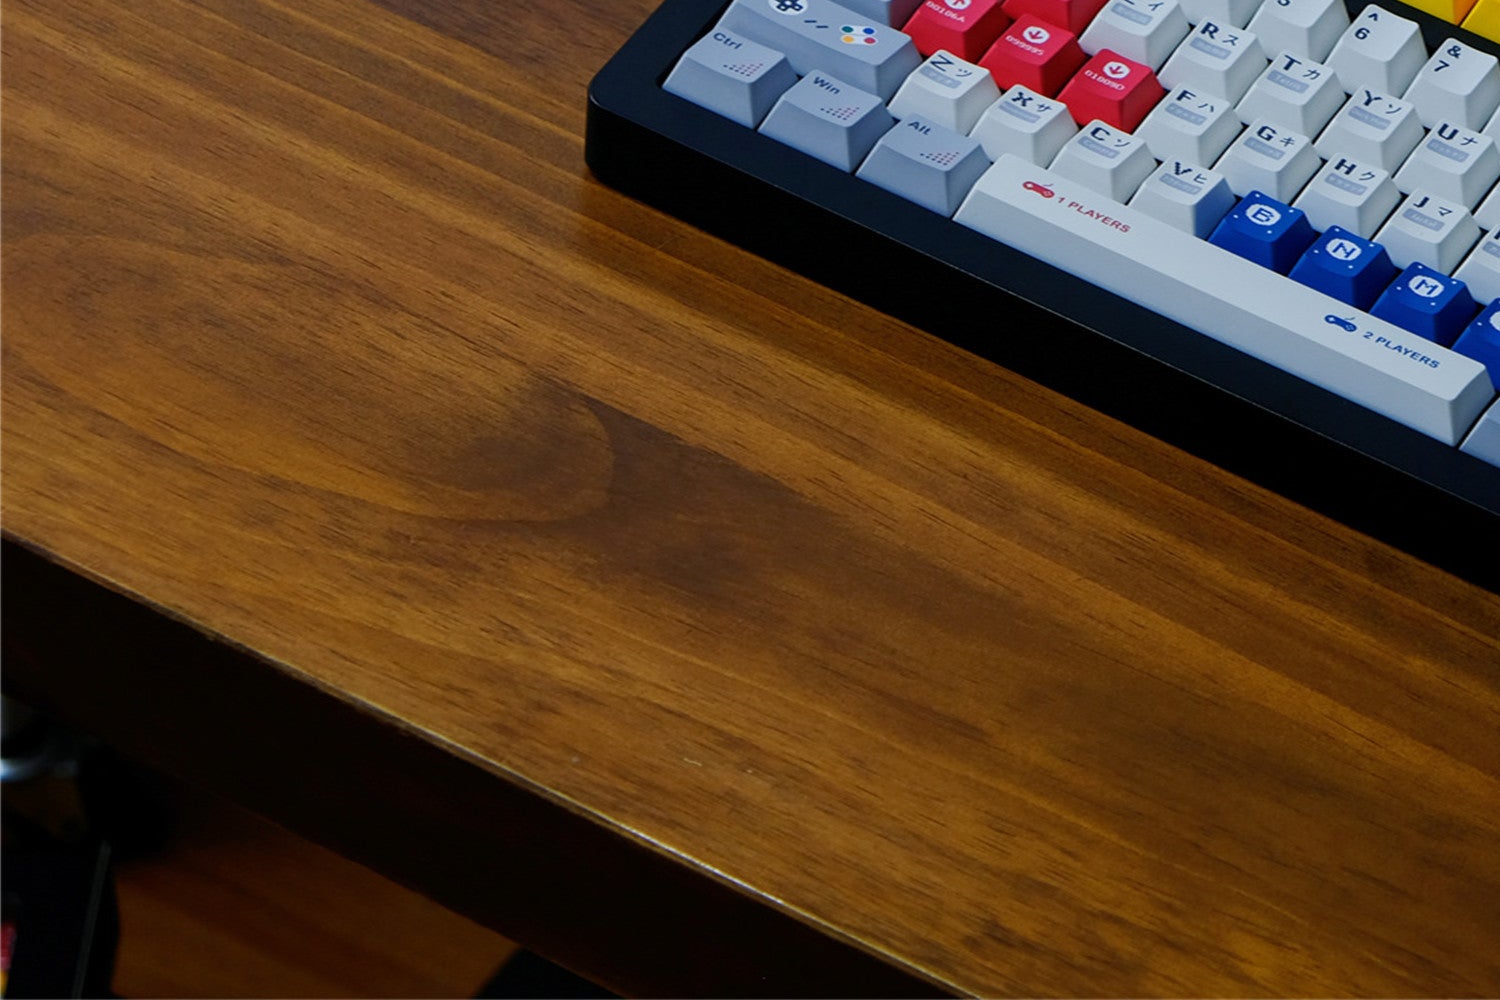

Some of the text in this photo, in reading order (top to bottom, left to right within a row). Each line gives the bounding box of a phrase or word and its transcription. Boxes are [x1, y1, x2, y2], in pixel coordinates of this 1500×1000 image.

[1200, 21, 1220, 40] R
[1354, 27, 1371, 41] 6
[713, 32, 743, 50] Ctrl
[1446, 44, 1462, 59] &
[930, 53, 955, 72] Z
[1282, 54, 1302, 71] T
[1433, 60, 1450, 73] 7
[812, 76, 841, 95] Win
[1011, 91, 1034, 108] X
[1176, 90, 1197, 102] F
[1362, 89, 1383, 107] Y
[907, 120, 932, 136] Alt
[1089, 126, 1111, 141] C
[1256, 125, 1277, 142] G
[1438, 123, 1460, 141] U
[1173, 161, 1192, 176] V
[1334, 158, 1357, 176] H
[1412, 196, 1430, 209] J
[1057, 196, 1131, 234] 1 PLAYERS
[1251, 206, 1275, 223] B
[1331, 242, 1357, 259] N
[1413, 278, 1438, 296] M
[1362, 331, 1441, 369] 2 PLAYERS
